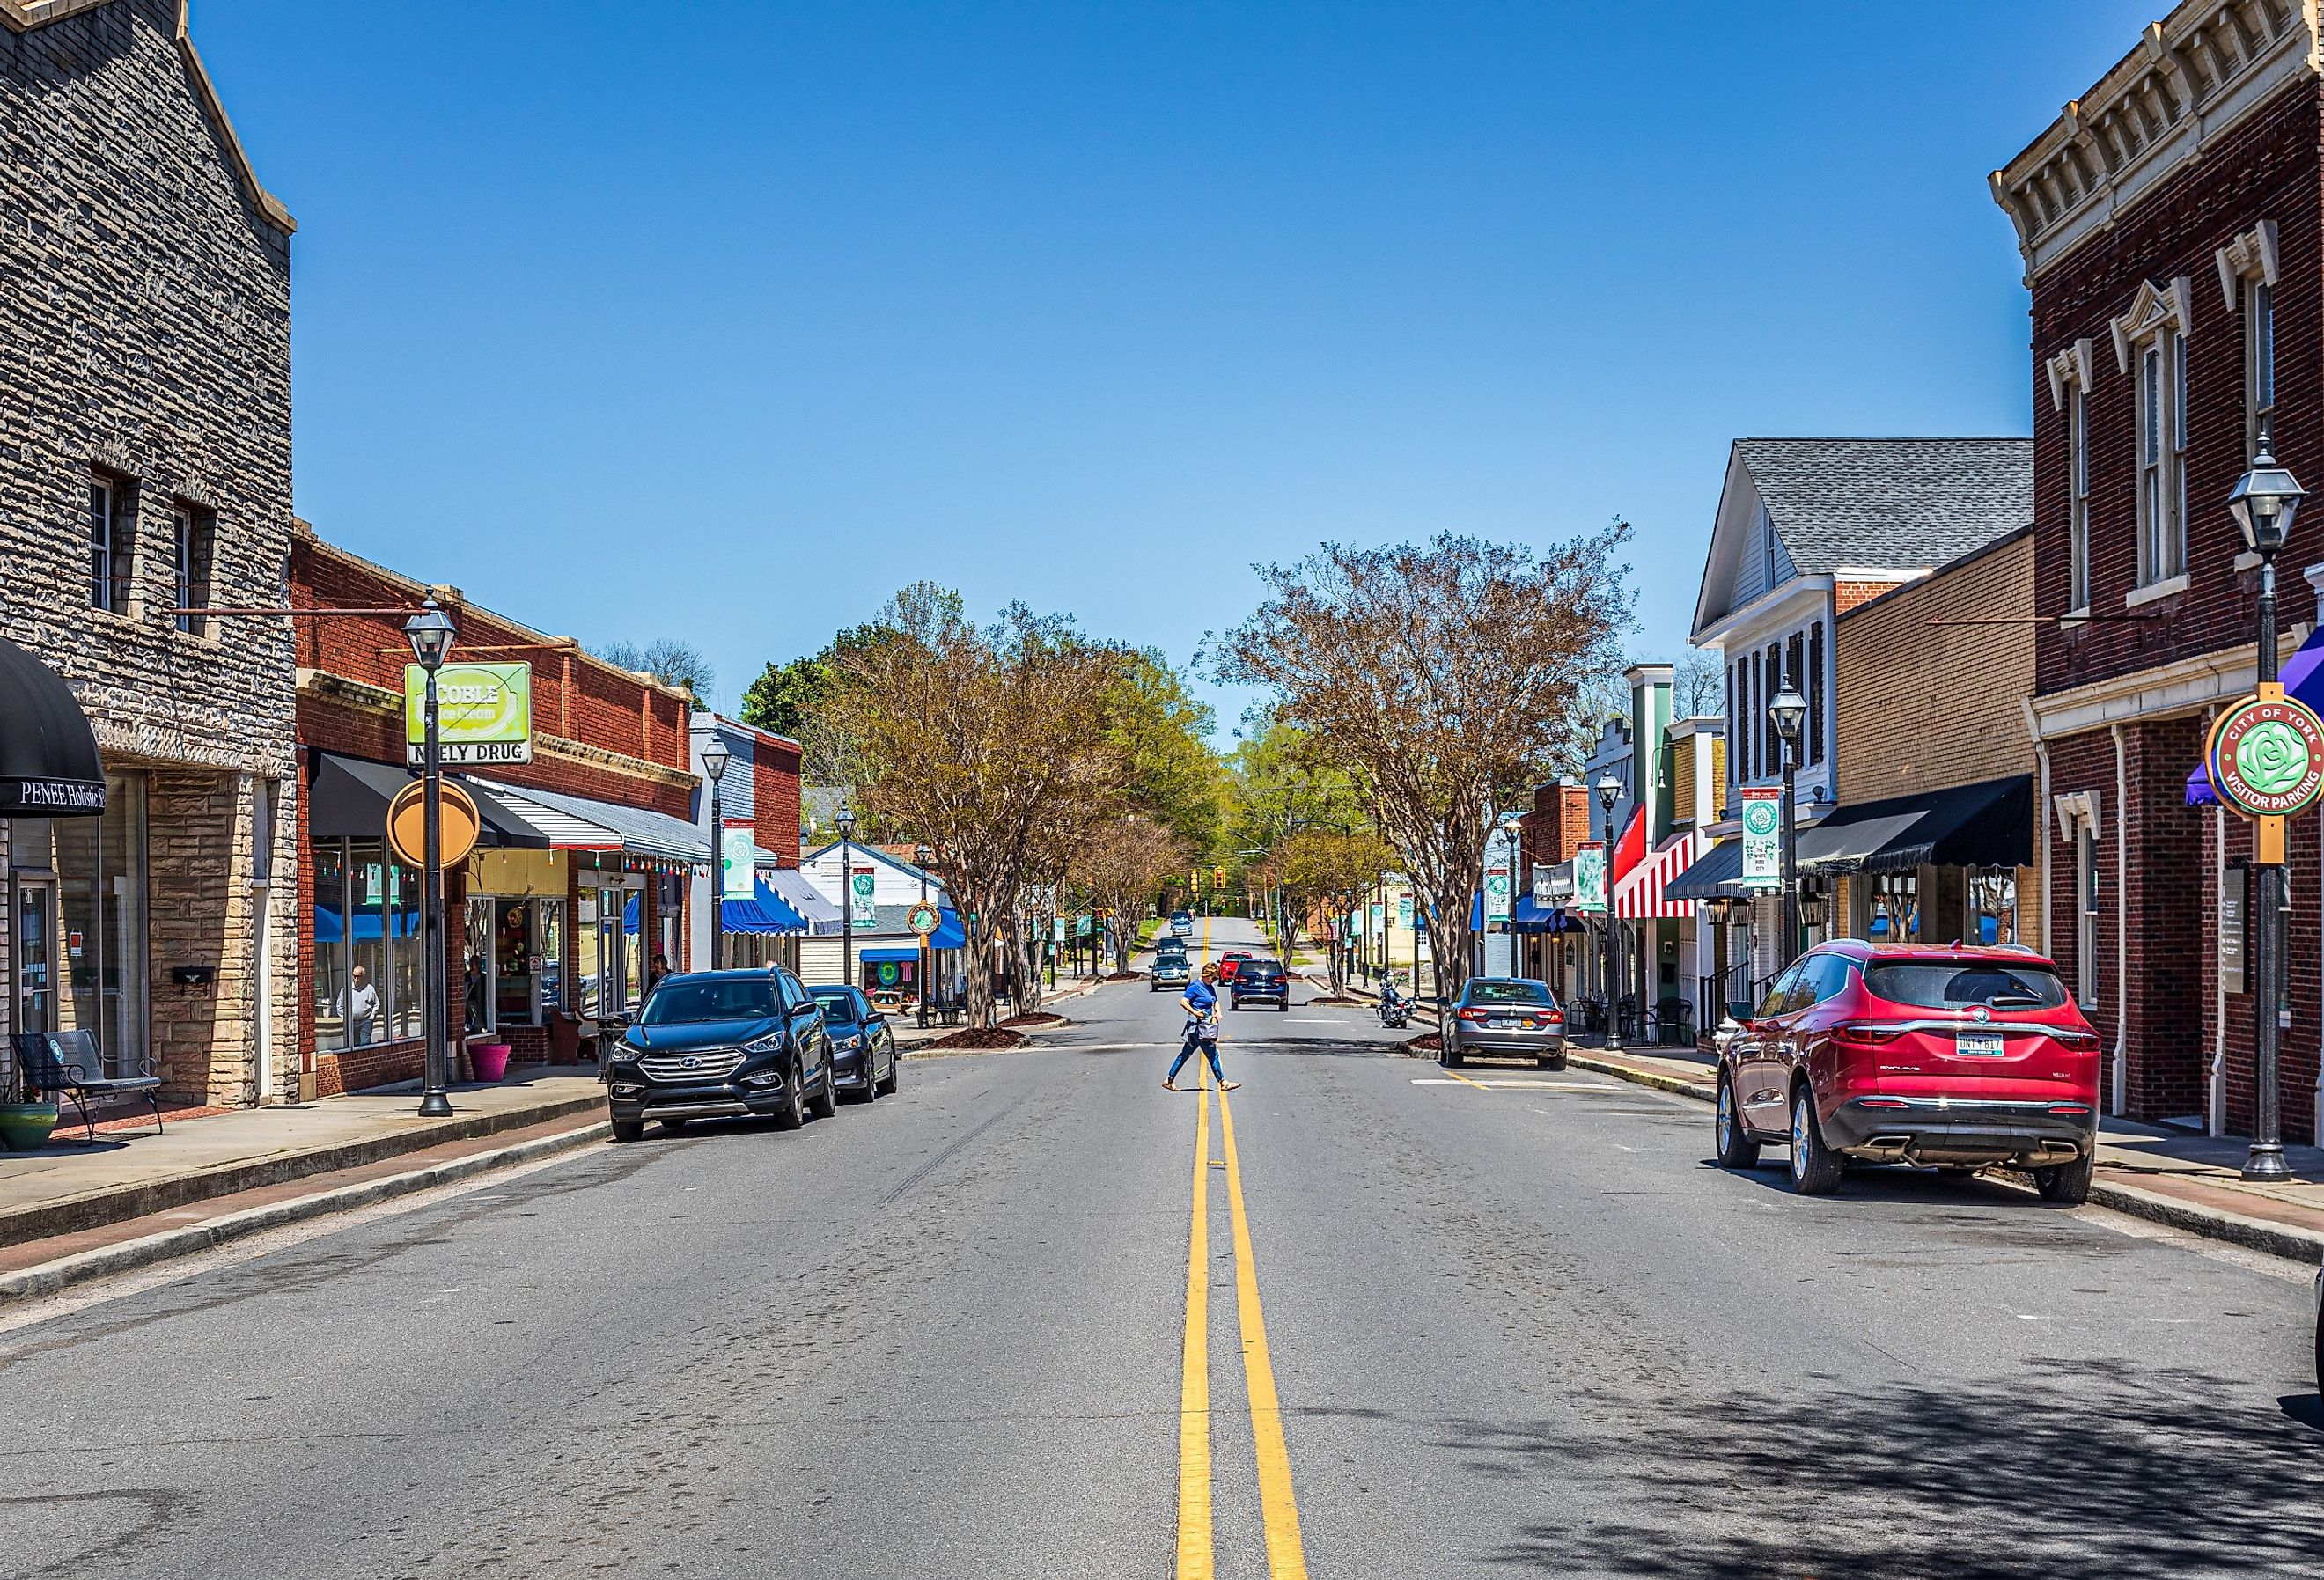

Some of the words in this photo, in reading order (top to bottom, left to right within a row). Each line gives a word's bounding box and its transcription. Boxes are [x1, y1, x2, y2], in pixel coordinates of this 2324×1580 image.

[436, 685, 498, 704] COBLE
[458, 707, 495, 720] Cream
[2229, 712, 2254, 740] CITY
[2261, 708, 2282, 717] OF
[2287, 711, 2319, 743] YORK
[415, 745, 468, 761] NELY
[476, 743, 523, 760] DRUG
[19, 781, 67, 805] PENEE
[65, 784, 99, 807] Holistic
[2225, 770, 2269, 808] VISITOR
[2271, 770, 2320, 809] PARKING
[1960, 1039, 1976, 1048] UNT
